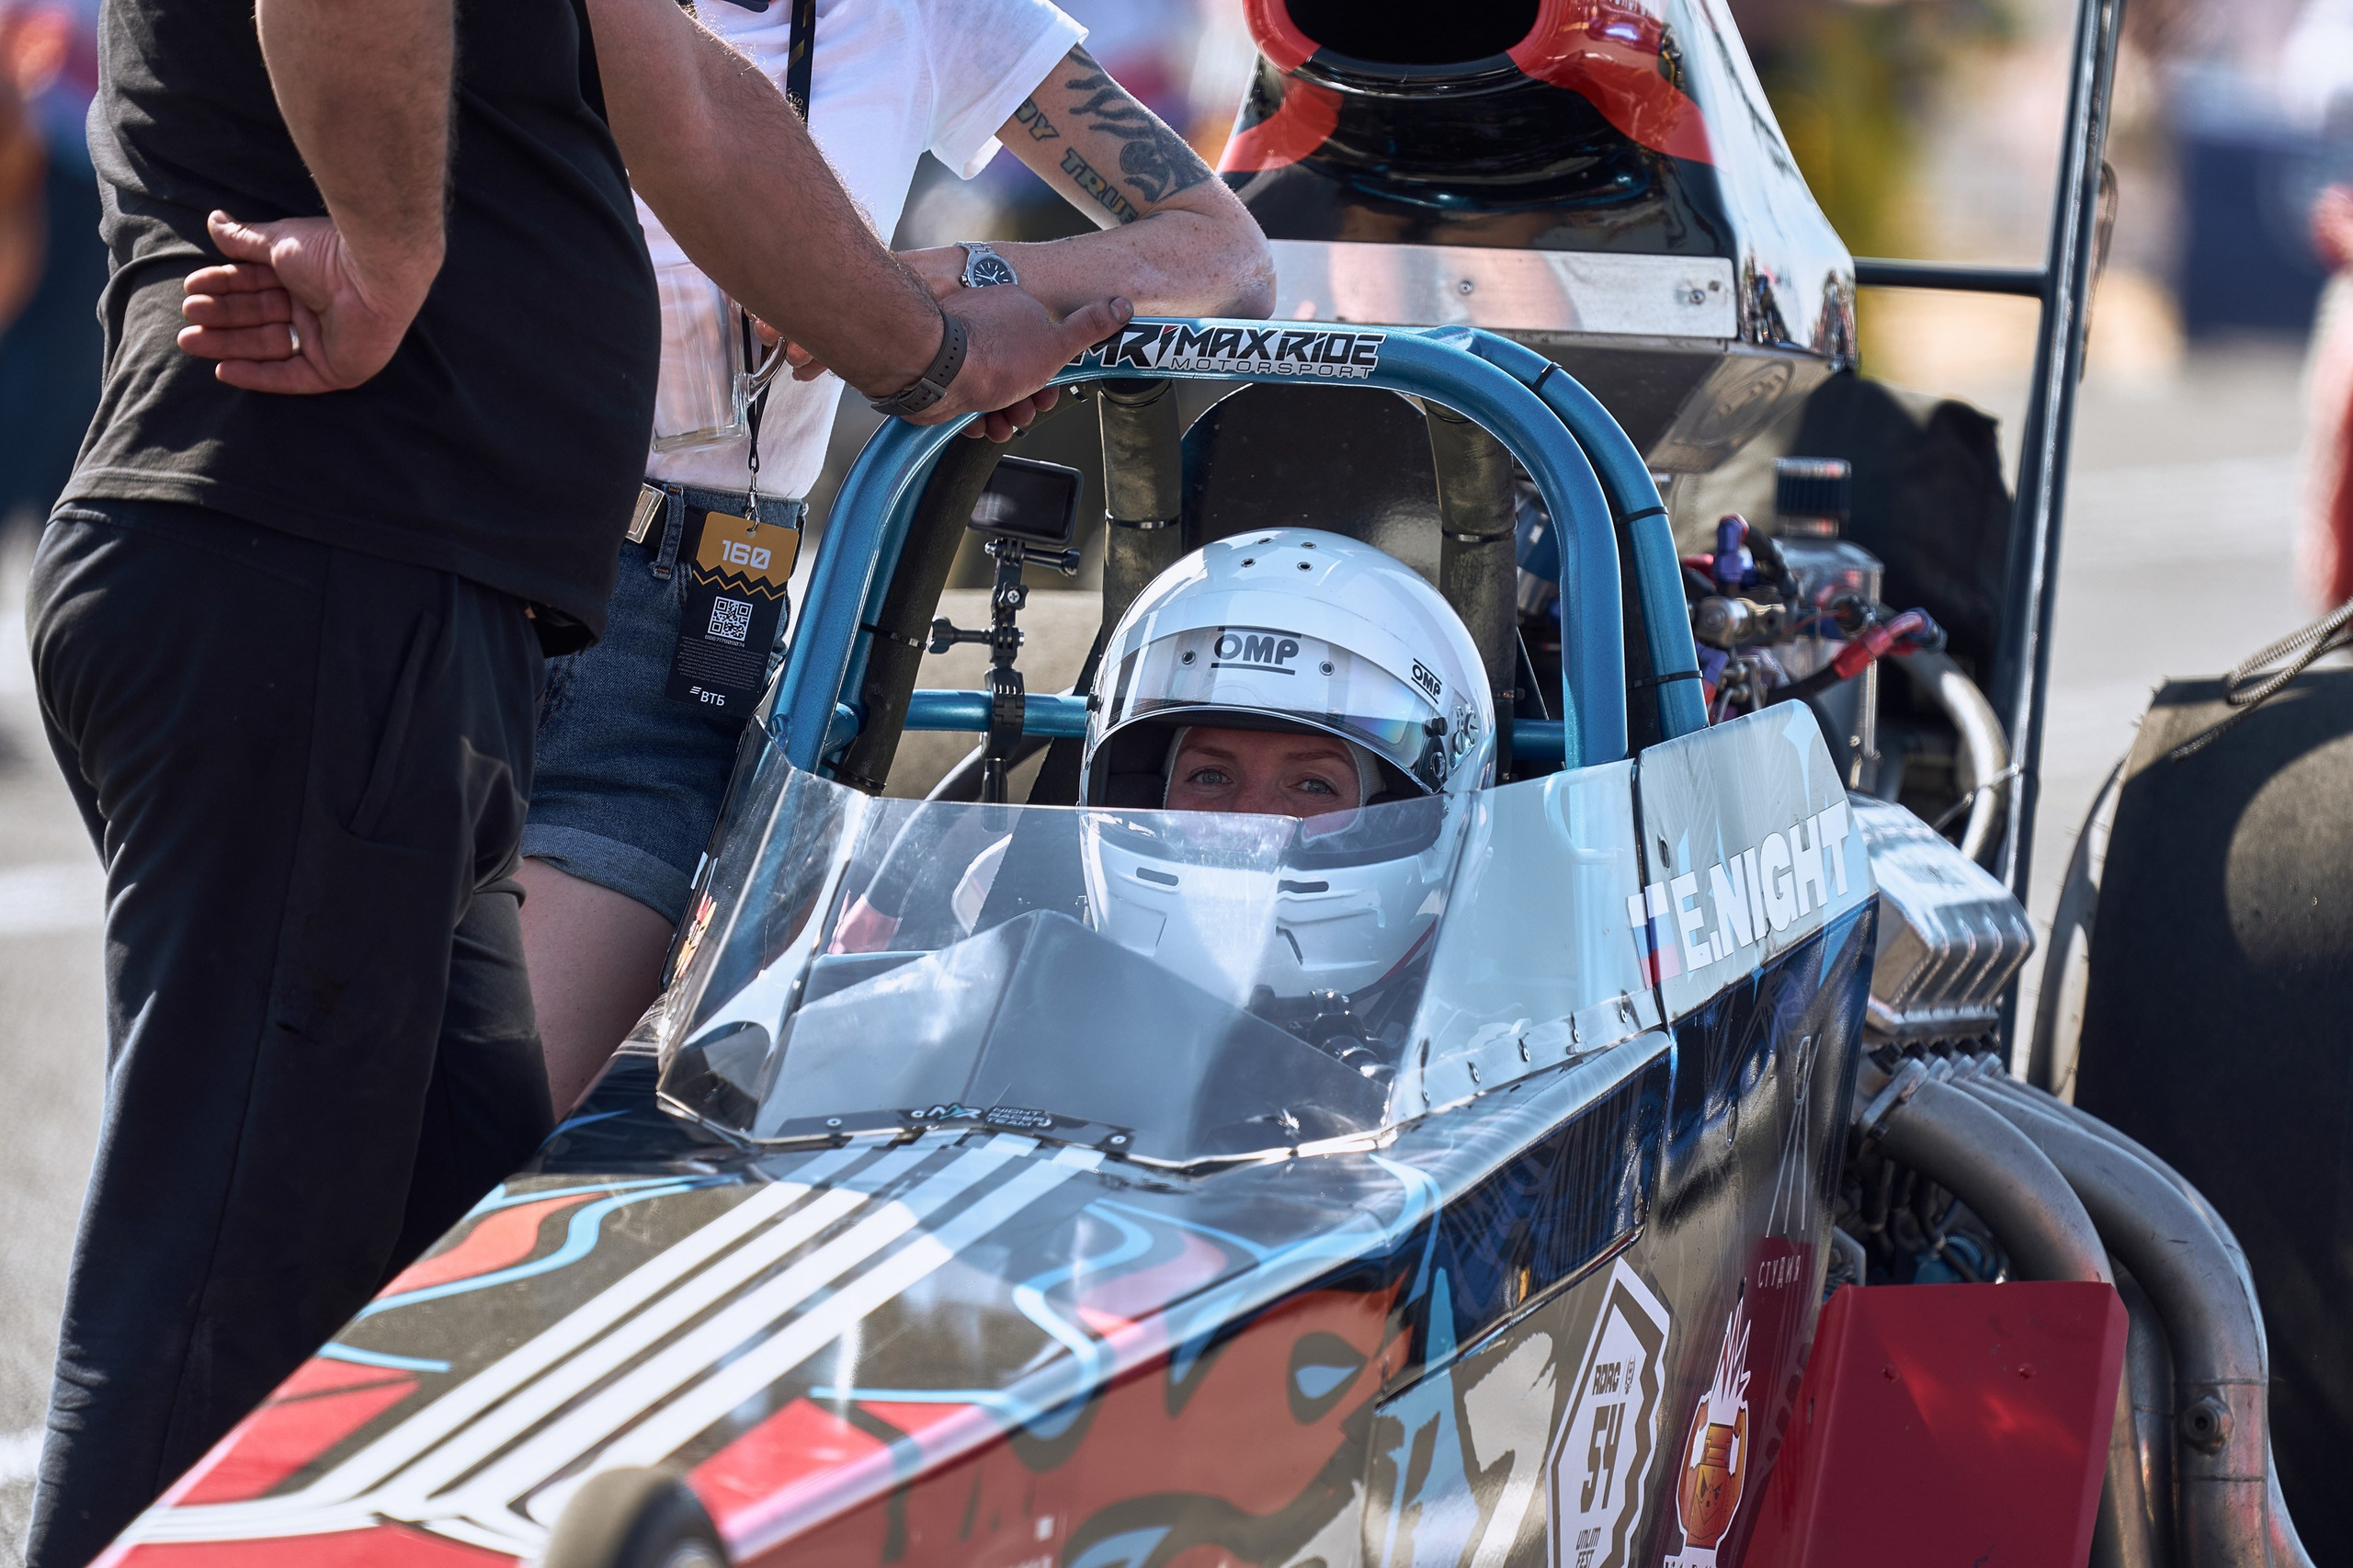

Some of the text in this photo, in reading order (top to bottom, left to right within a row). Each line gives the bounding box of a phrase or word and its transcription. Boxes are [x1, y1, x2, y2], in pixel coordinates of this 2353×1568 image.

[1170, 358, 1375, 379] MOTORSPORT
[722, 540, 771, 570] 160
[1213, 633, 1300, 665] OMP
[1412, 664, 1441, 697] OMP
[700, 691, 726, 706] ВТБ
[1757, 1255, 1802, 1290] СТУДИЯ
